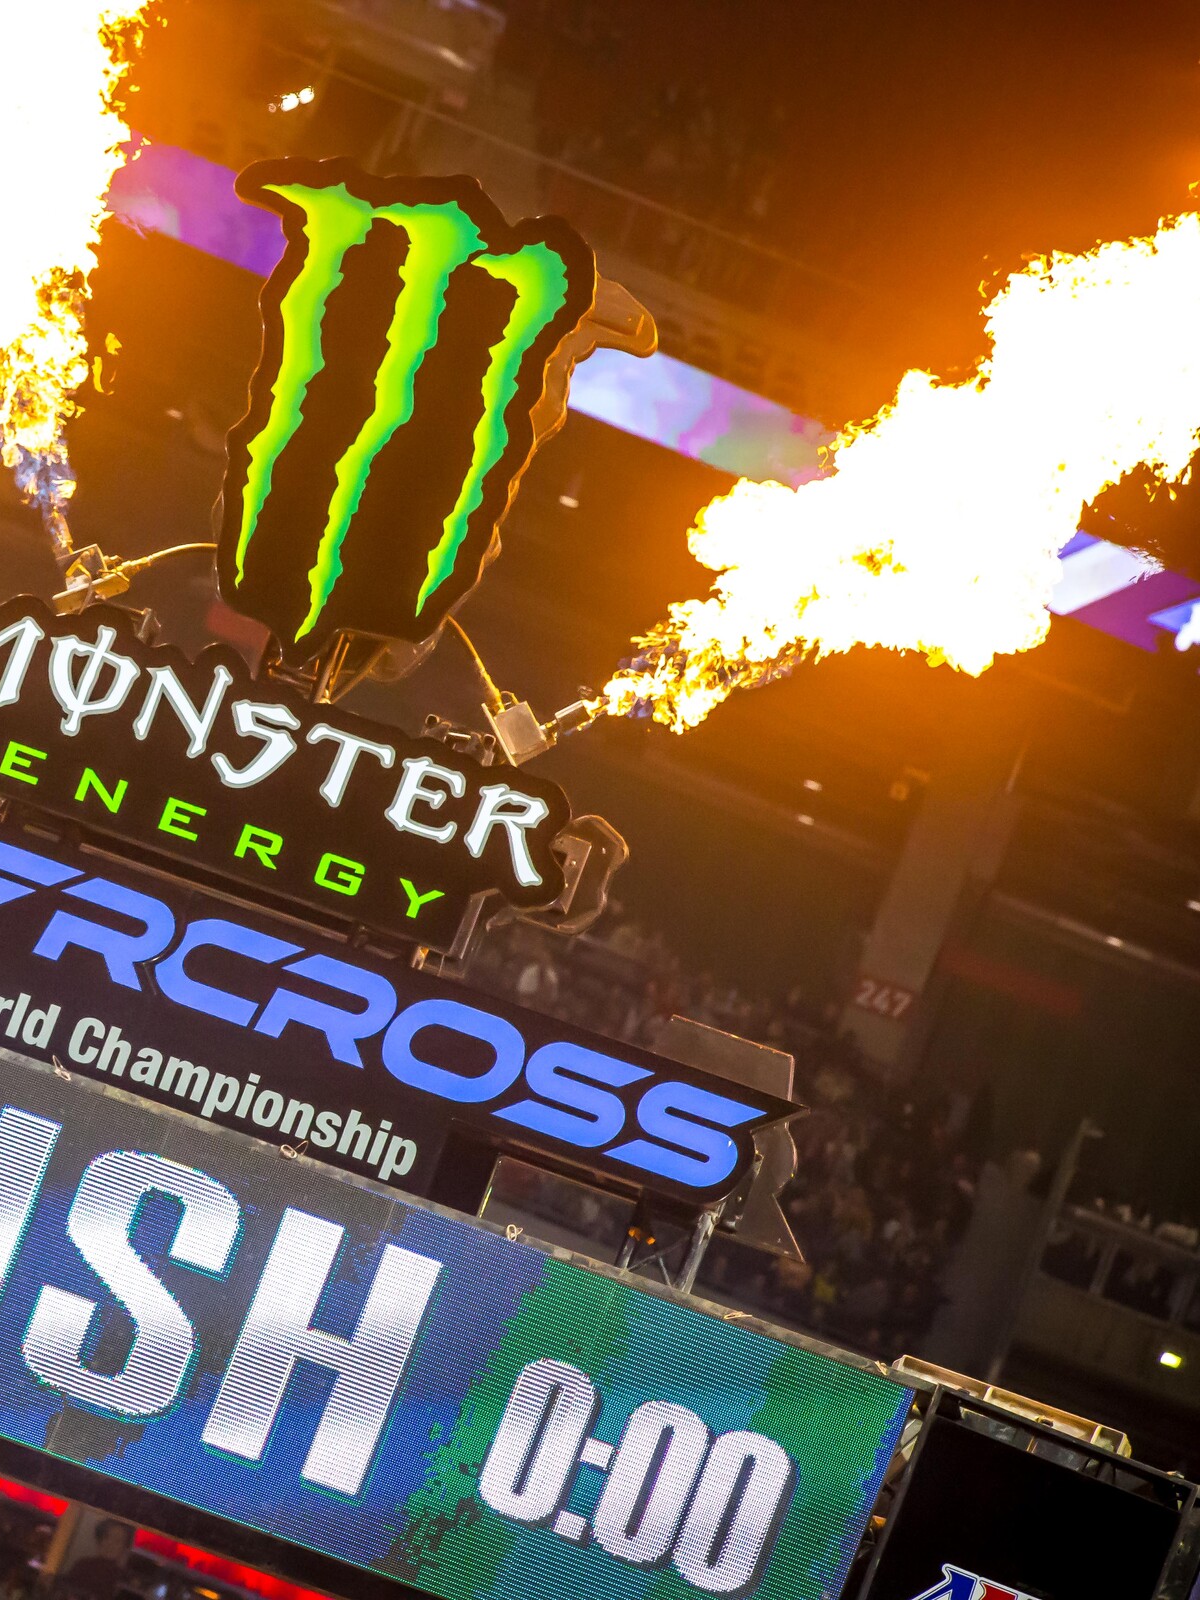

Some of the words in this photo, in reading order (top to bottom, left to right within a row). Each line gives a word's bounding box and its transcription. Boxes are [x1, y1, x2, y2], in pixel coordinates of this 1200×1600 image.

[0, 741, 445, 919] ENERGY
[68, 1014, 418, 1178] Championship
[477, 1356, 792, 1593] 0:00
